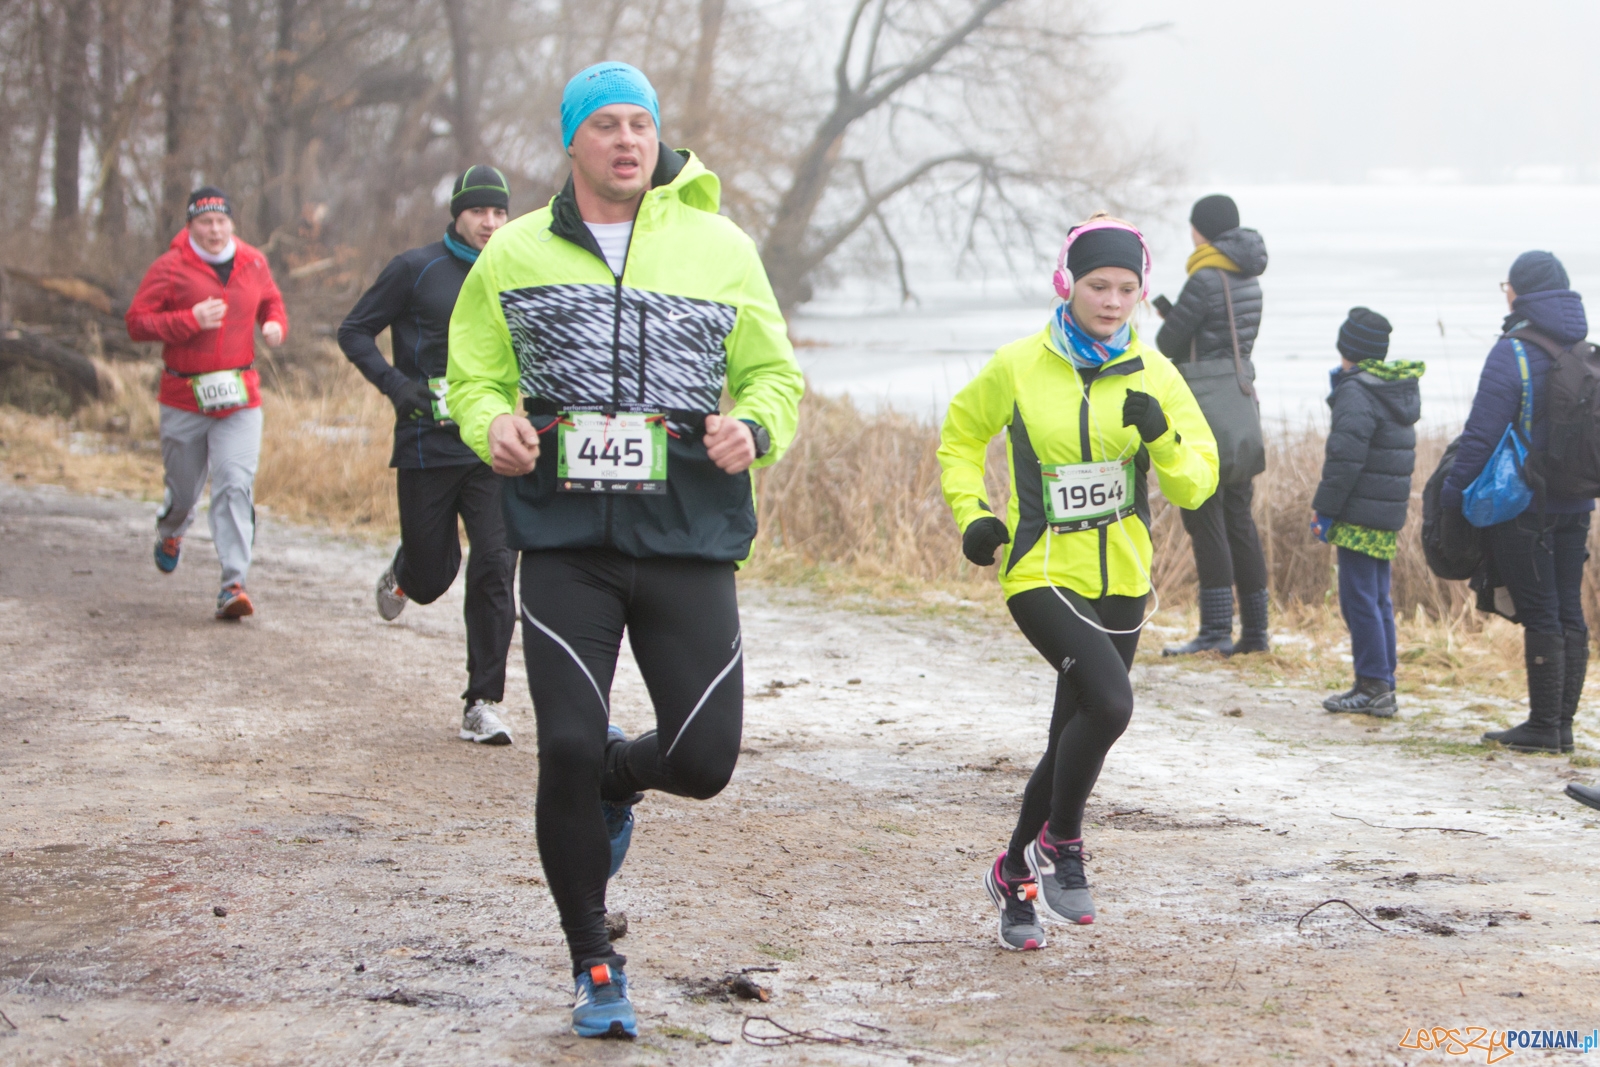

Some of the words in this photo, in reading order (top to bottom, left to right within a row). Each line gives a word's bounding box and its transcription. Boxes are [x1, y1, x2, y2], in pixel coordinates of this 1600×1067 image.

[202, 382, 238, 400] 1060
[562, 403, 604, 412] performance
[577, 437, 644, 467] 445
[601, 469, 618, 478] KRIS
[1057, 480, 1123, 510] 1964
